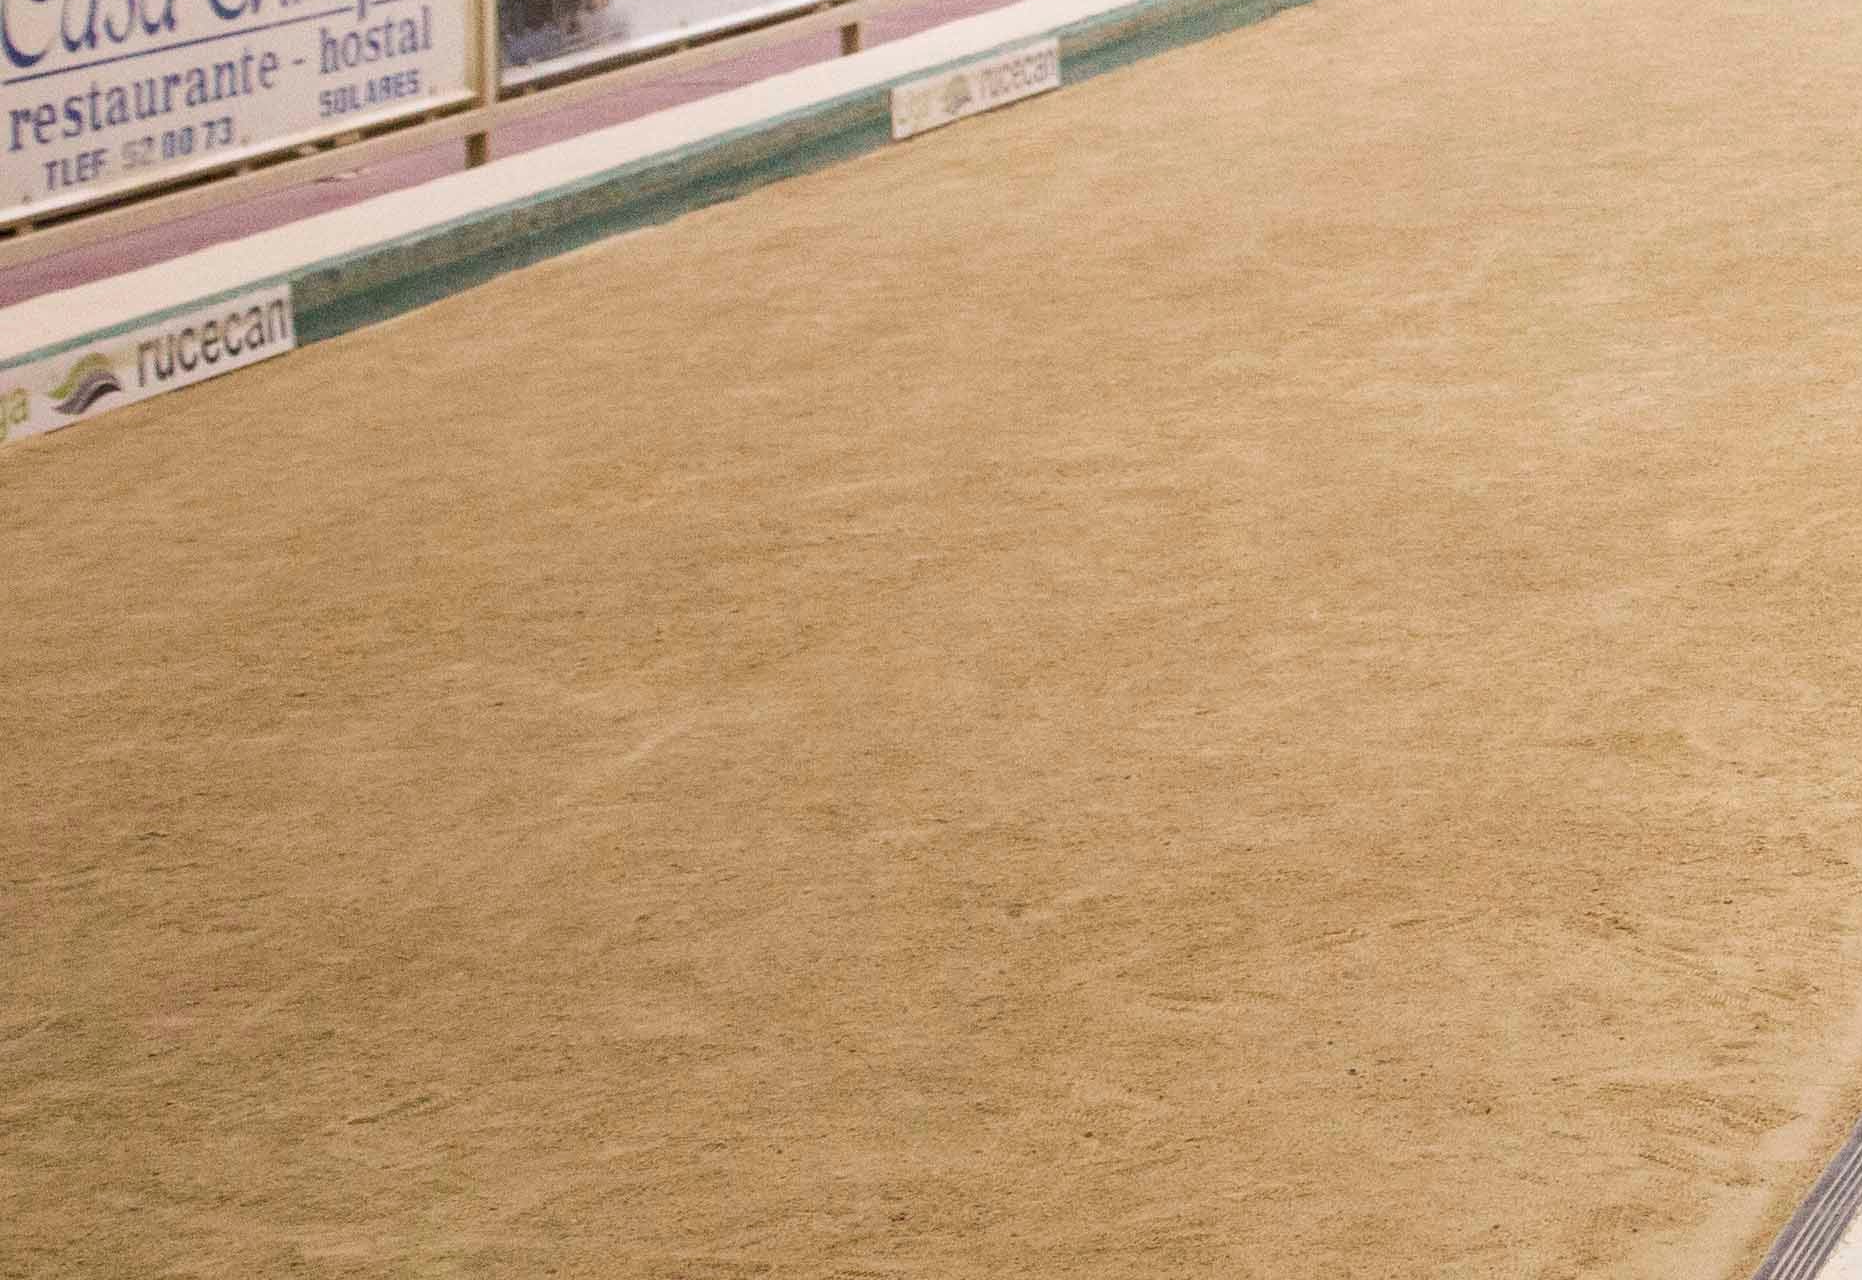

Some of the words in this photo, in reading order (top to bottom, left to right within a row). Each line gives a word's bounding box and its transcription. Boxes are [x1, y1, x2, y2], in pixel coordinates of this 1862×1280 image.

[6, 47, 281, 153] restaurante
[318, 4, 433, 76] hostal
[318, 68, 421, 119] SOLARES
[136, 297, 289, 388] rucecan
